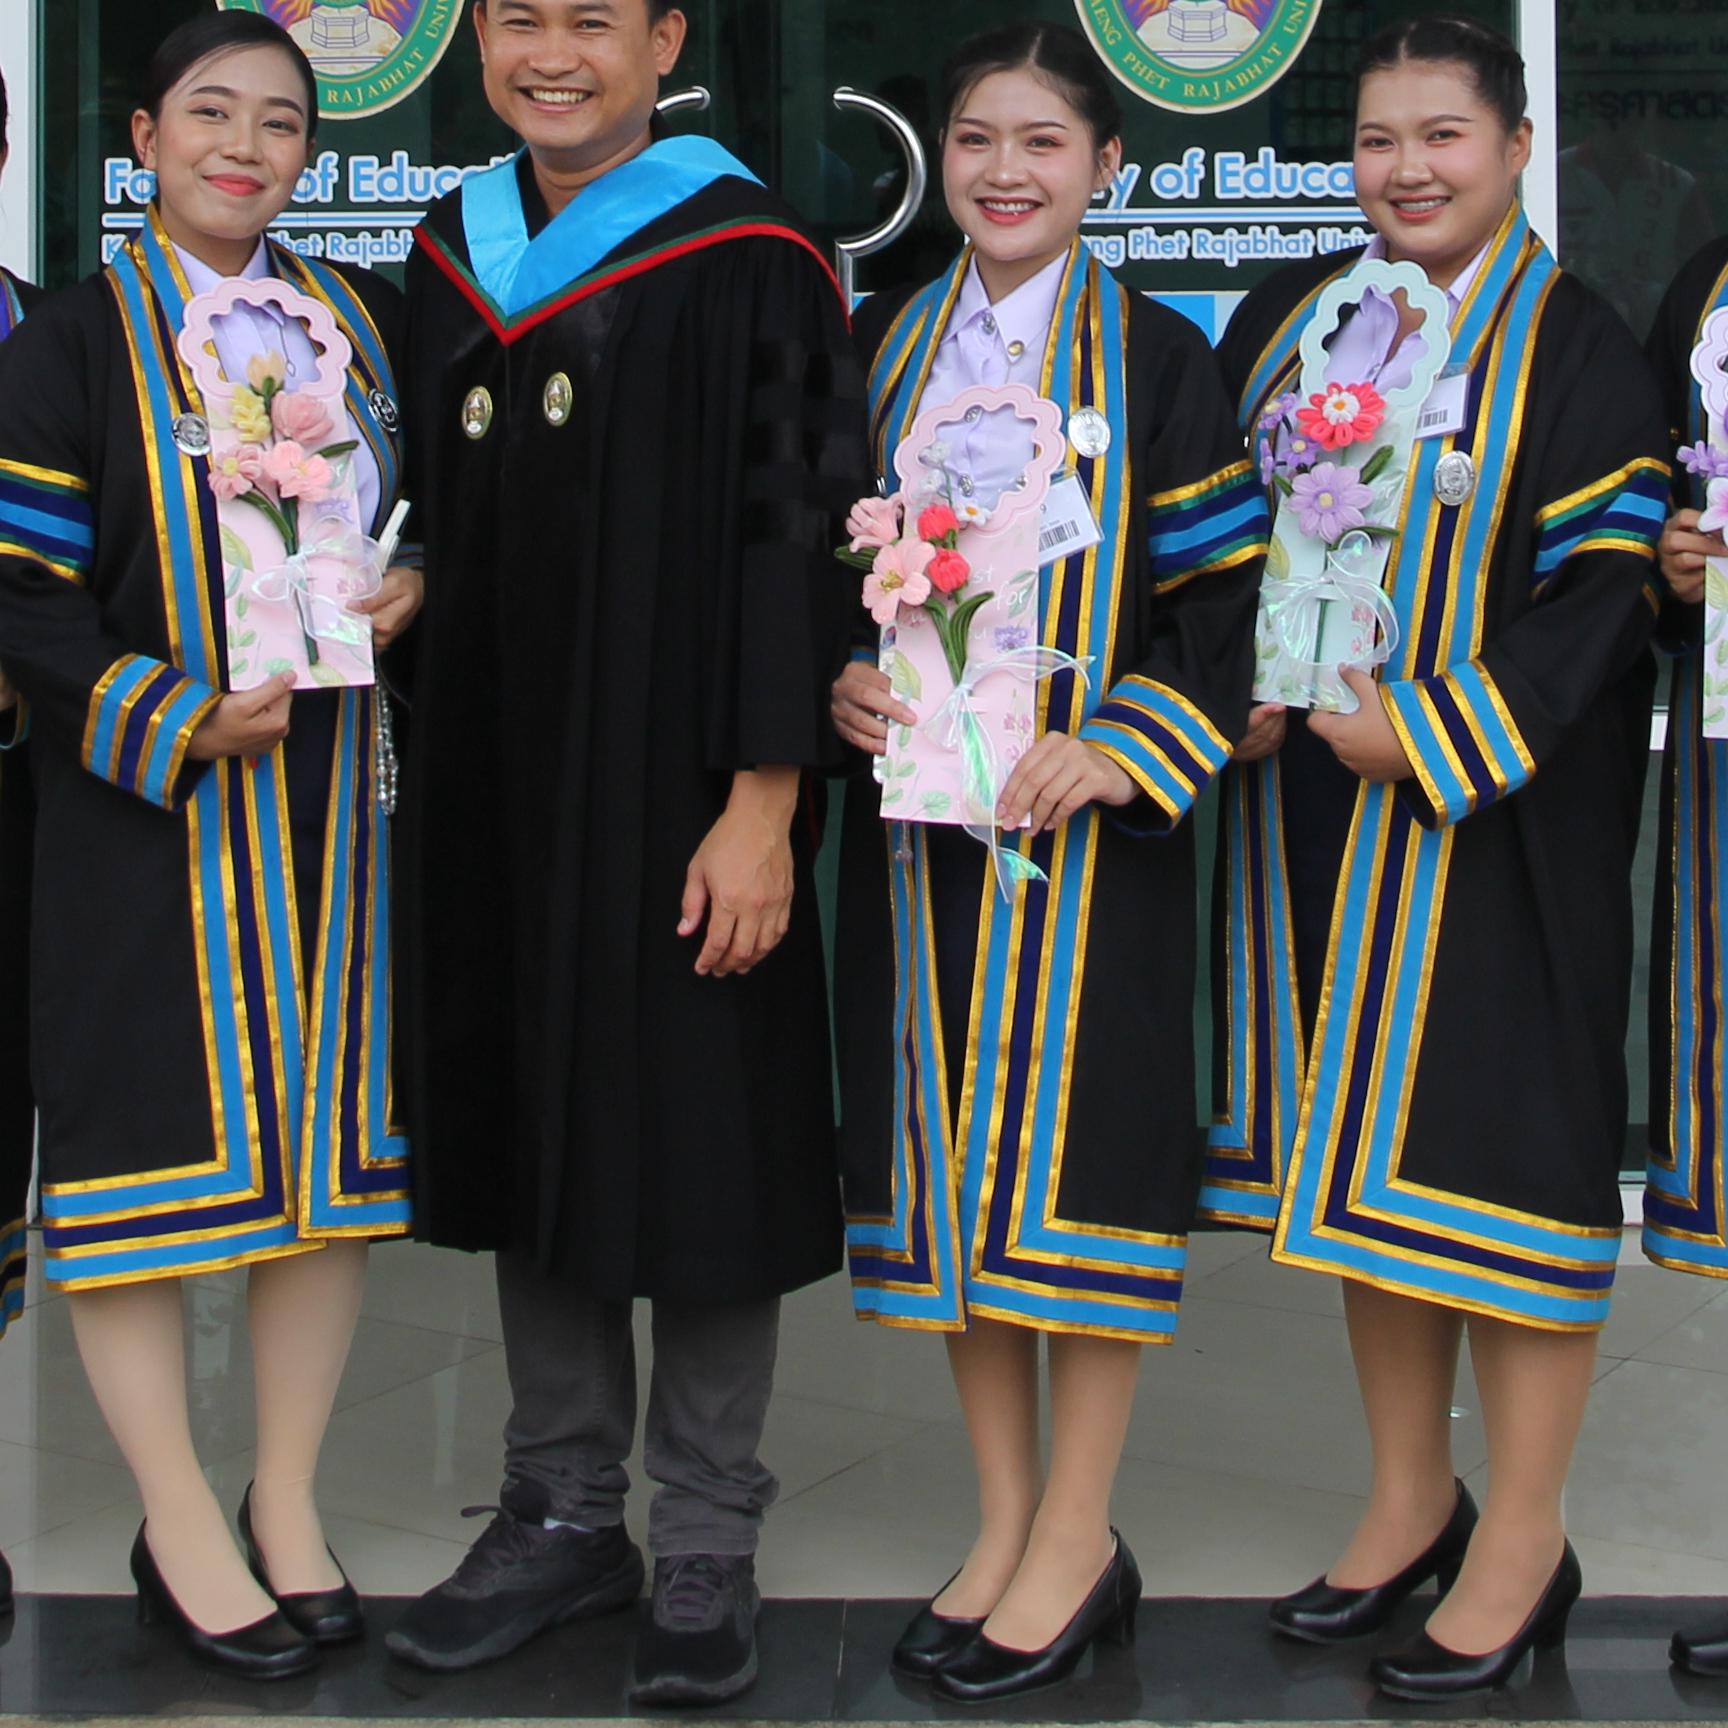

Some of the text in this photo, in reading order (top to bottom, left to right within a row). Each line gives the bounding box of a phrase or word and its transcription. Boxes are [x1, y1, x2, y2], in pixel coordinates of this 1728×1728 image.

[326, 47, 424, 105] RAJABHAT
[1123, 51, 1170, 90] PHET
[1183, 43, 1283, 101] RAJABHAT
[292, 154, 336, 199] of
[1152, 150, 1205, 195] of
[1217, 151, 1356, 195] Educa
[270, 232, 323, 257] het
[1131, 230, 1189, 256] Phet
[1195, 229, 1313, 265] Rajabhat
